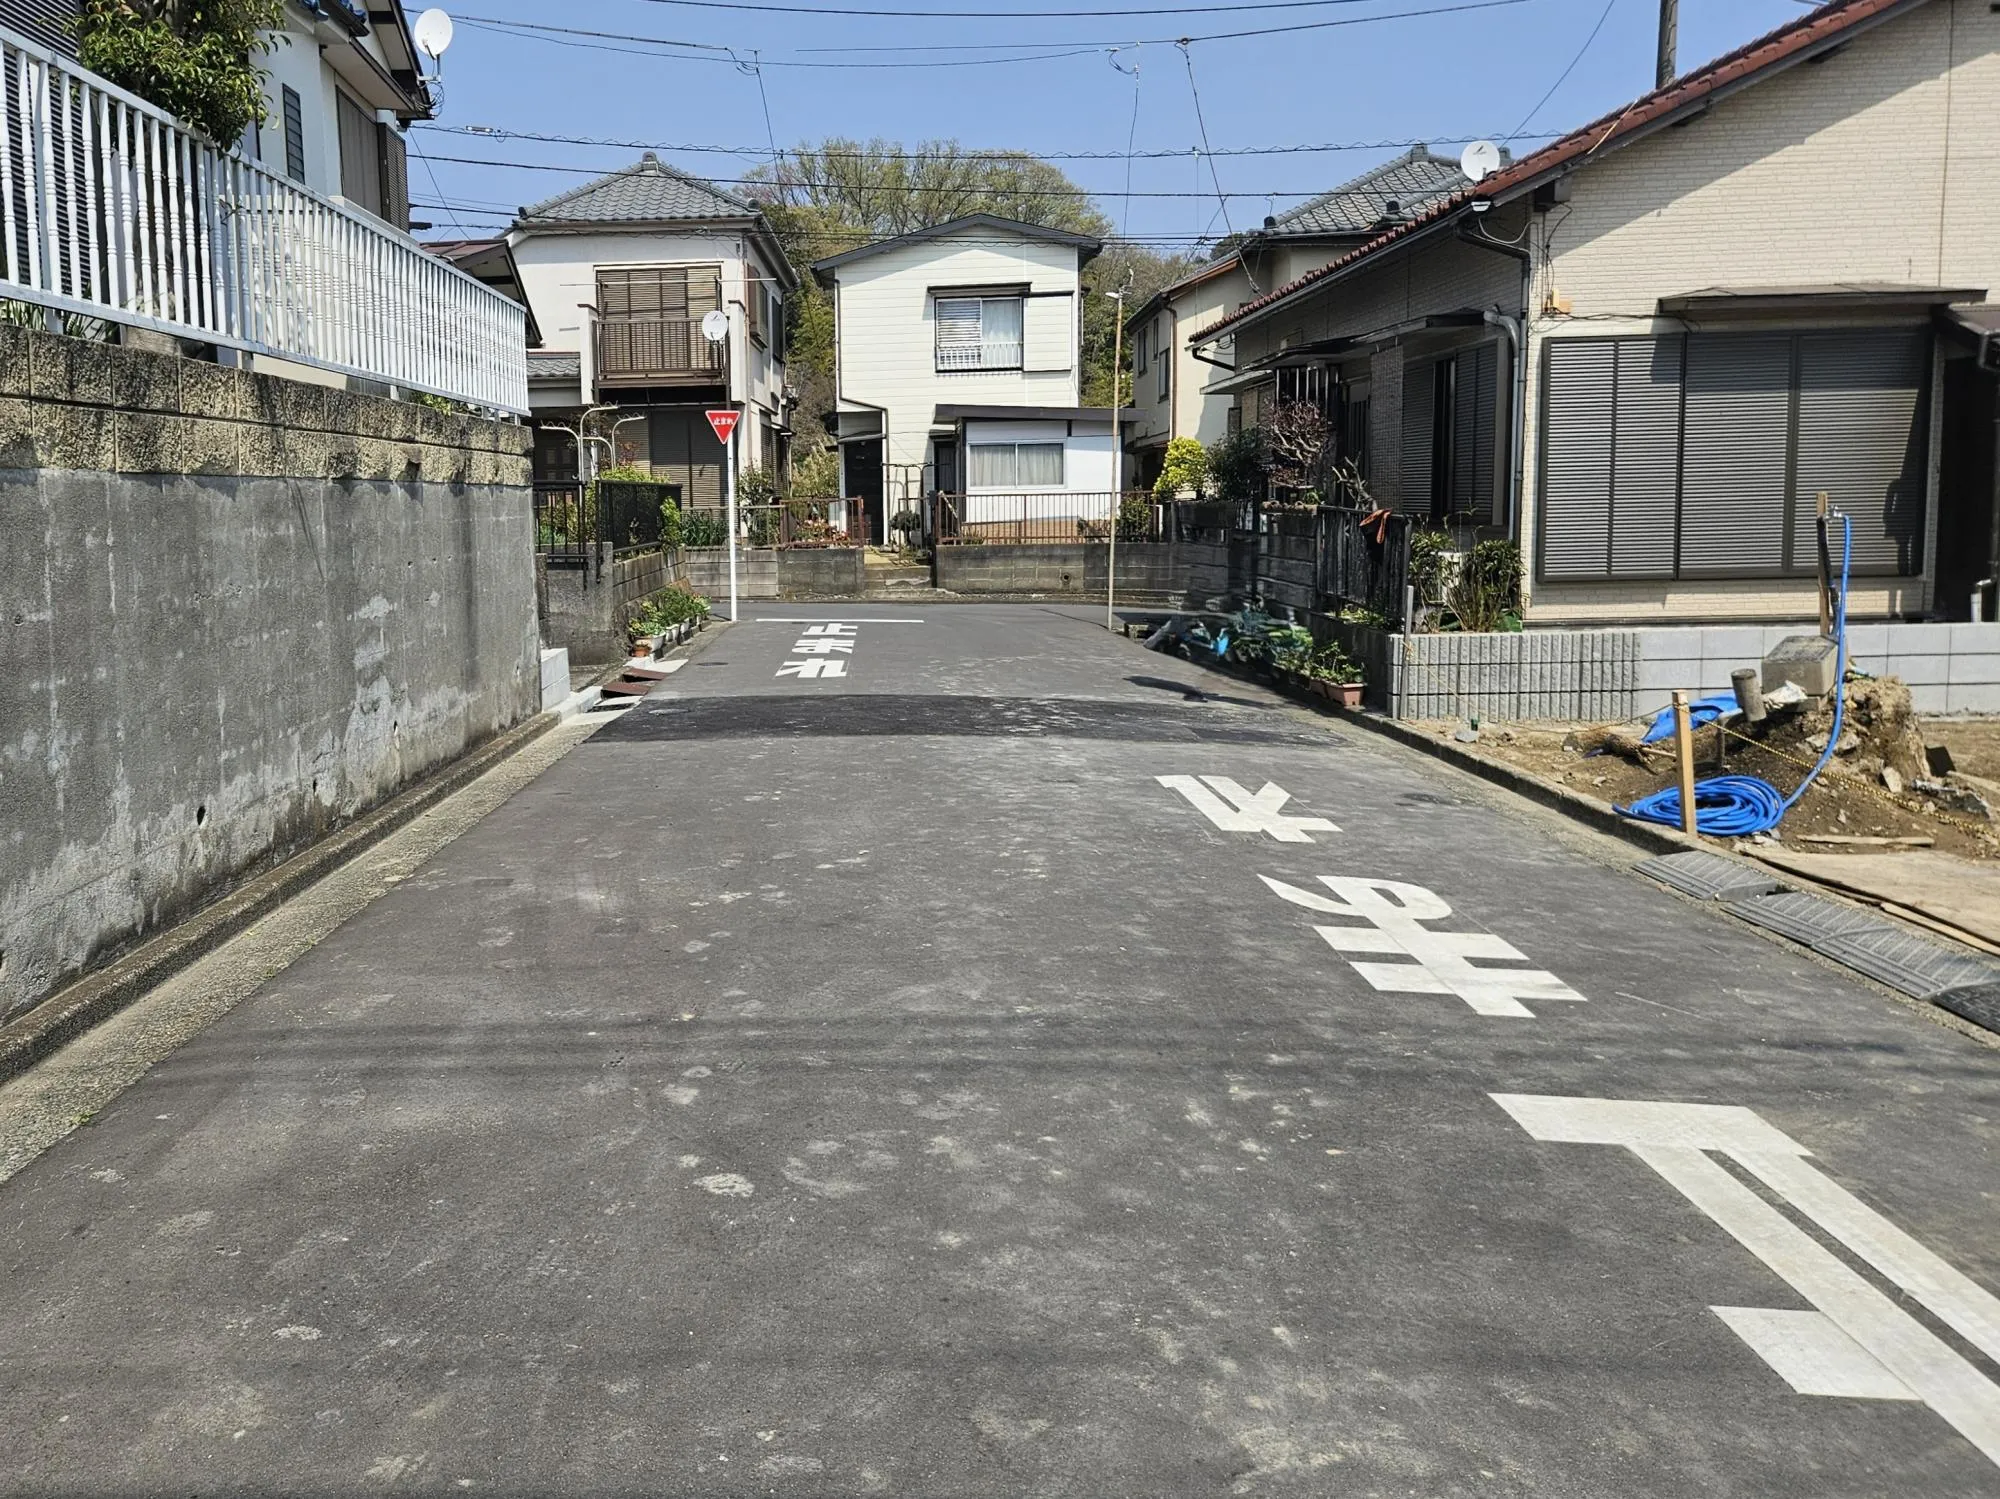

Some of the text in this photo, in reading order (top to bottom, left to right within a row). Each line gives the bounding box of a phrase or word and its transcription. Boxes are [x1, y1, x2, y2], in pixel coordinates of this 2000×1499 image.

[713, 416, 734, 426] 止まれ
[775, 622, 858, 678] 止まれ
